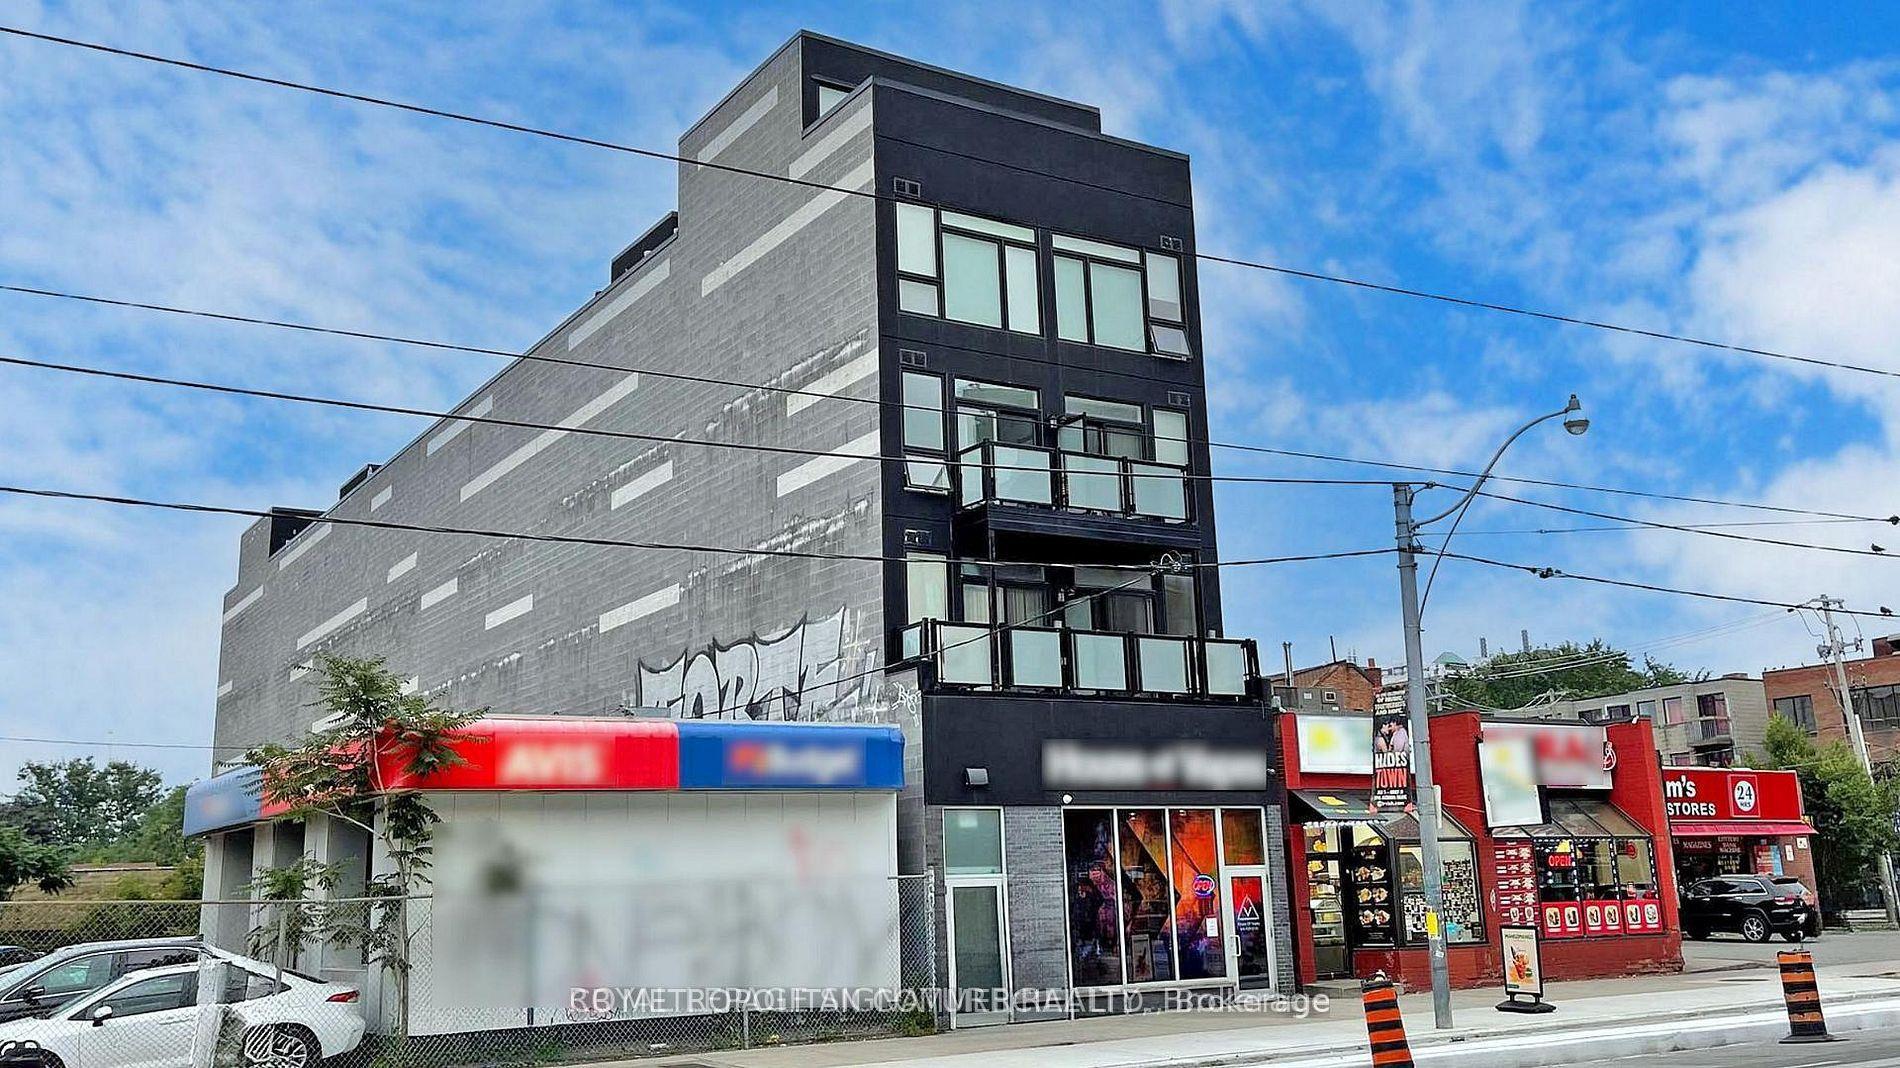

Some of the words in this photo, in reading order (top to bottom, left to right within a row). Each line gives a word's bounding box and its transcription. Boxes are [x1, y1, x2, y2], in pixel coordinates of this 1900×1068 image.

[1375, 768, 1407, 789] TOWN
[1737, 785, 1752, 800] 24
[1667, 802, 1716, 816] STORES
[1548, 855, 1572, 867] OPEN
